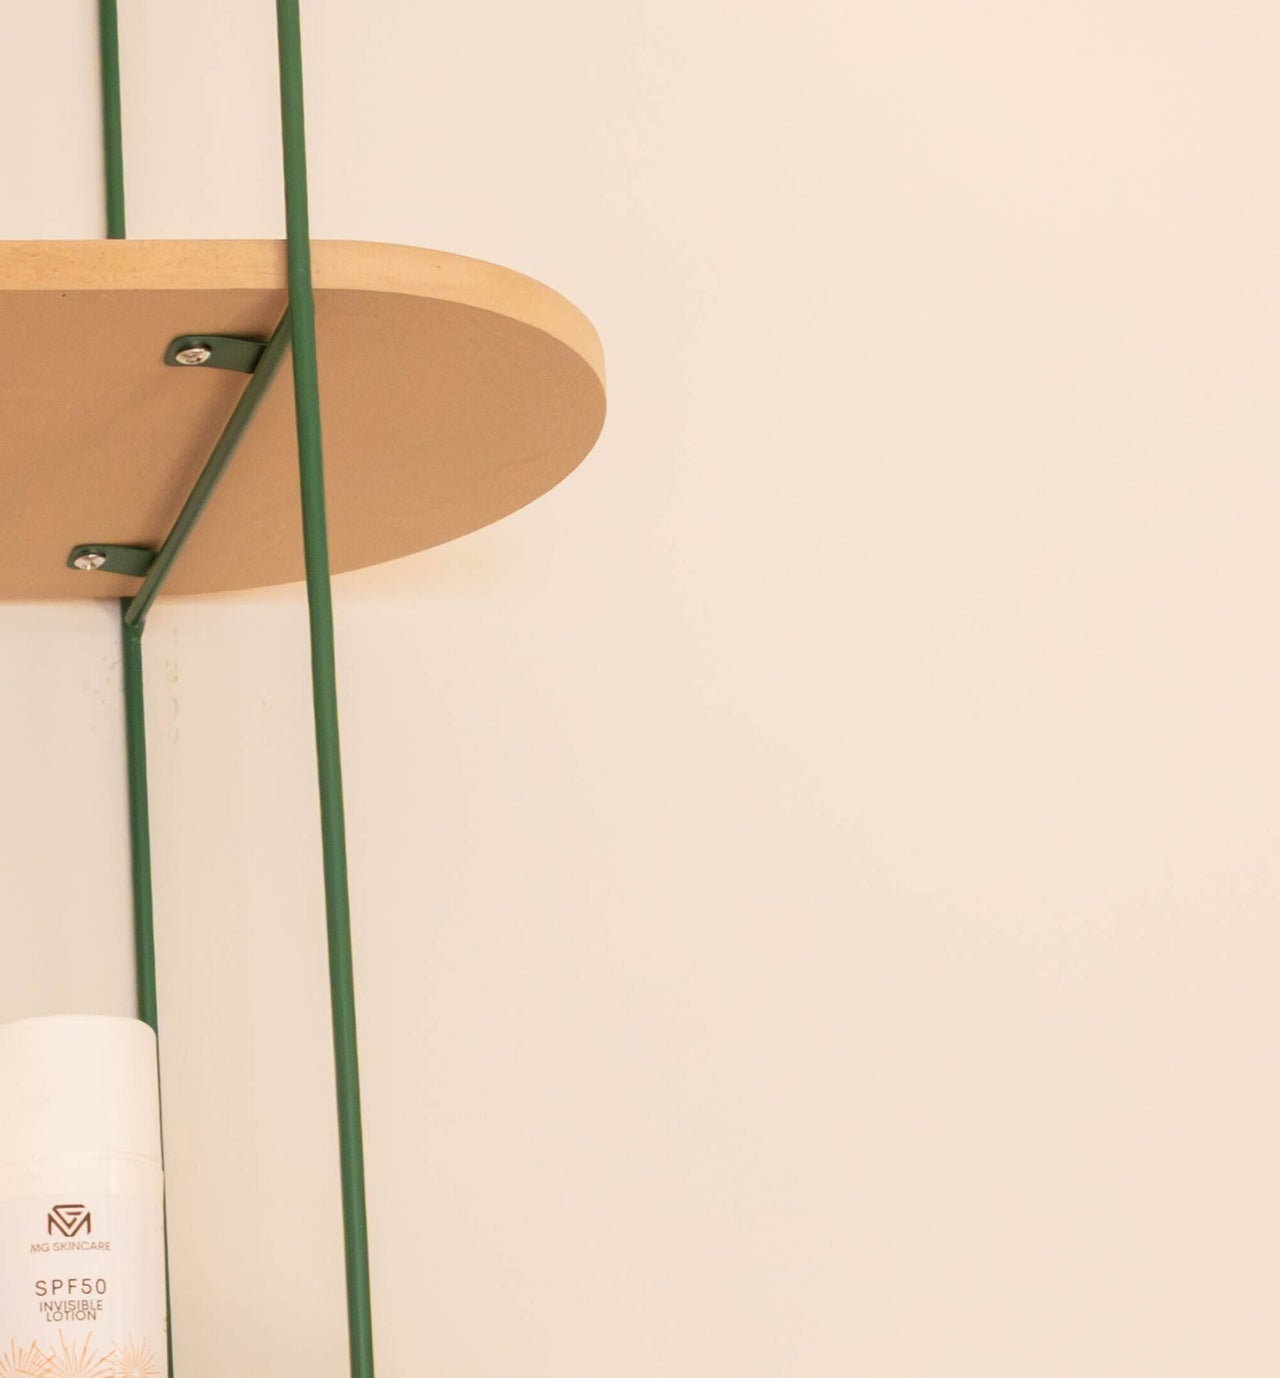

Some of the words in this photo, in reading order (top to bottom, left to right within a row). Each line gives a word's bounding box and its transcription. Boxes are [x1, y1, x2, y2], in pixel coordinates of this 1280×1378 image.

[30, 1243, 50, 1253] MG
[52, 1241, 111, 1252] SKINCARE
[35, 1278, 107, 1296] SPF50
[40, 1300, 104, 1313] INVISIBLE
[46, 1310, 97, 1322] LOTION
